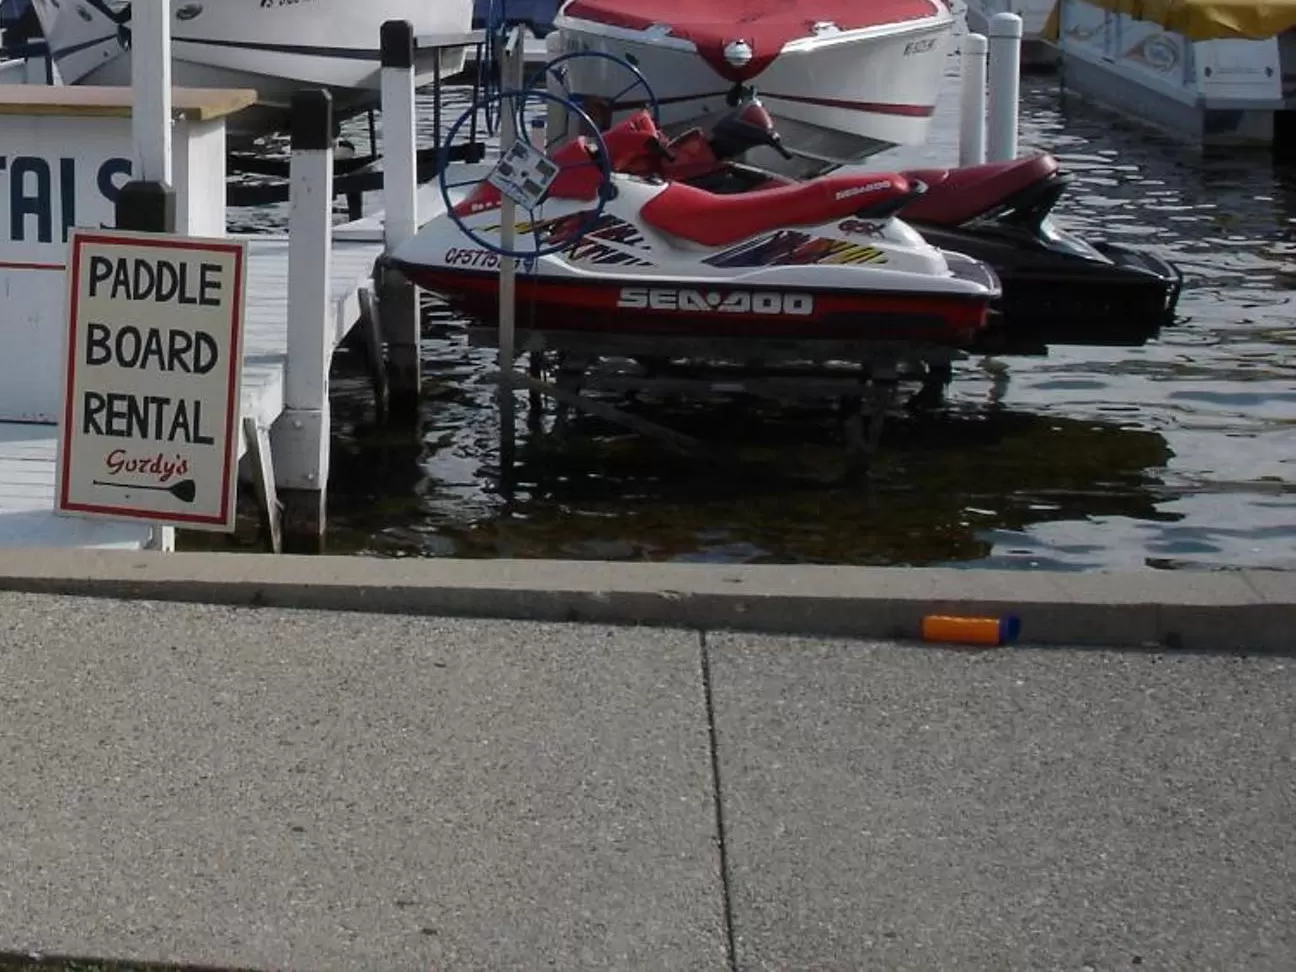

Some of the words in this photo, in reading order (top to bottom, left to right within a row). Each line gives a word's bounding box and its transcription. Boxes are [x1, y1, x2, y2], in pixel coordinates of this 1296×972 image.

[89, 256, 222, 306] PADDLE
[86, 323, 219, 374] BOARD
[83, 391, 215, 445] RENTAL
[106, 449, 188, 482] Gordy's
